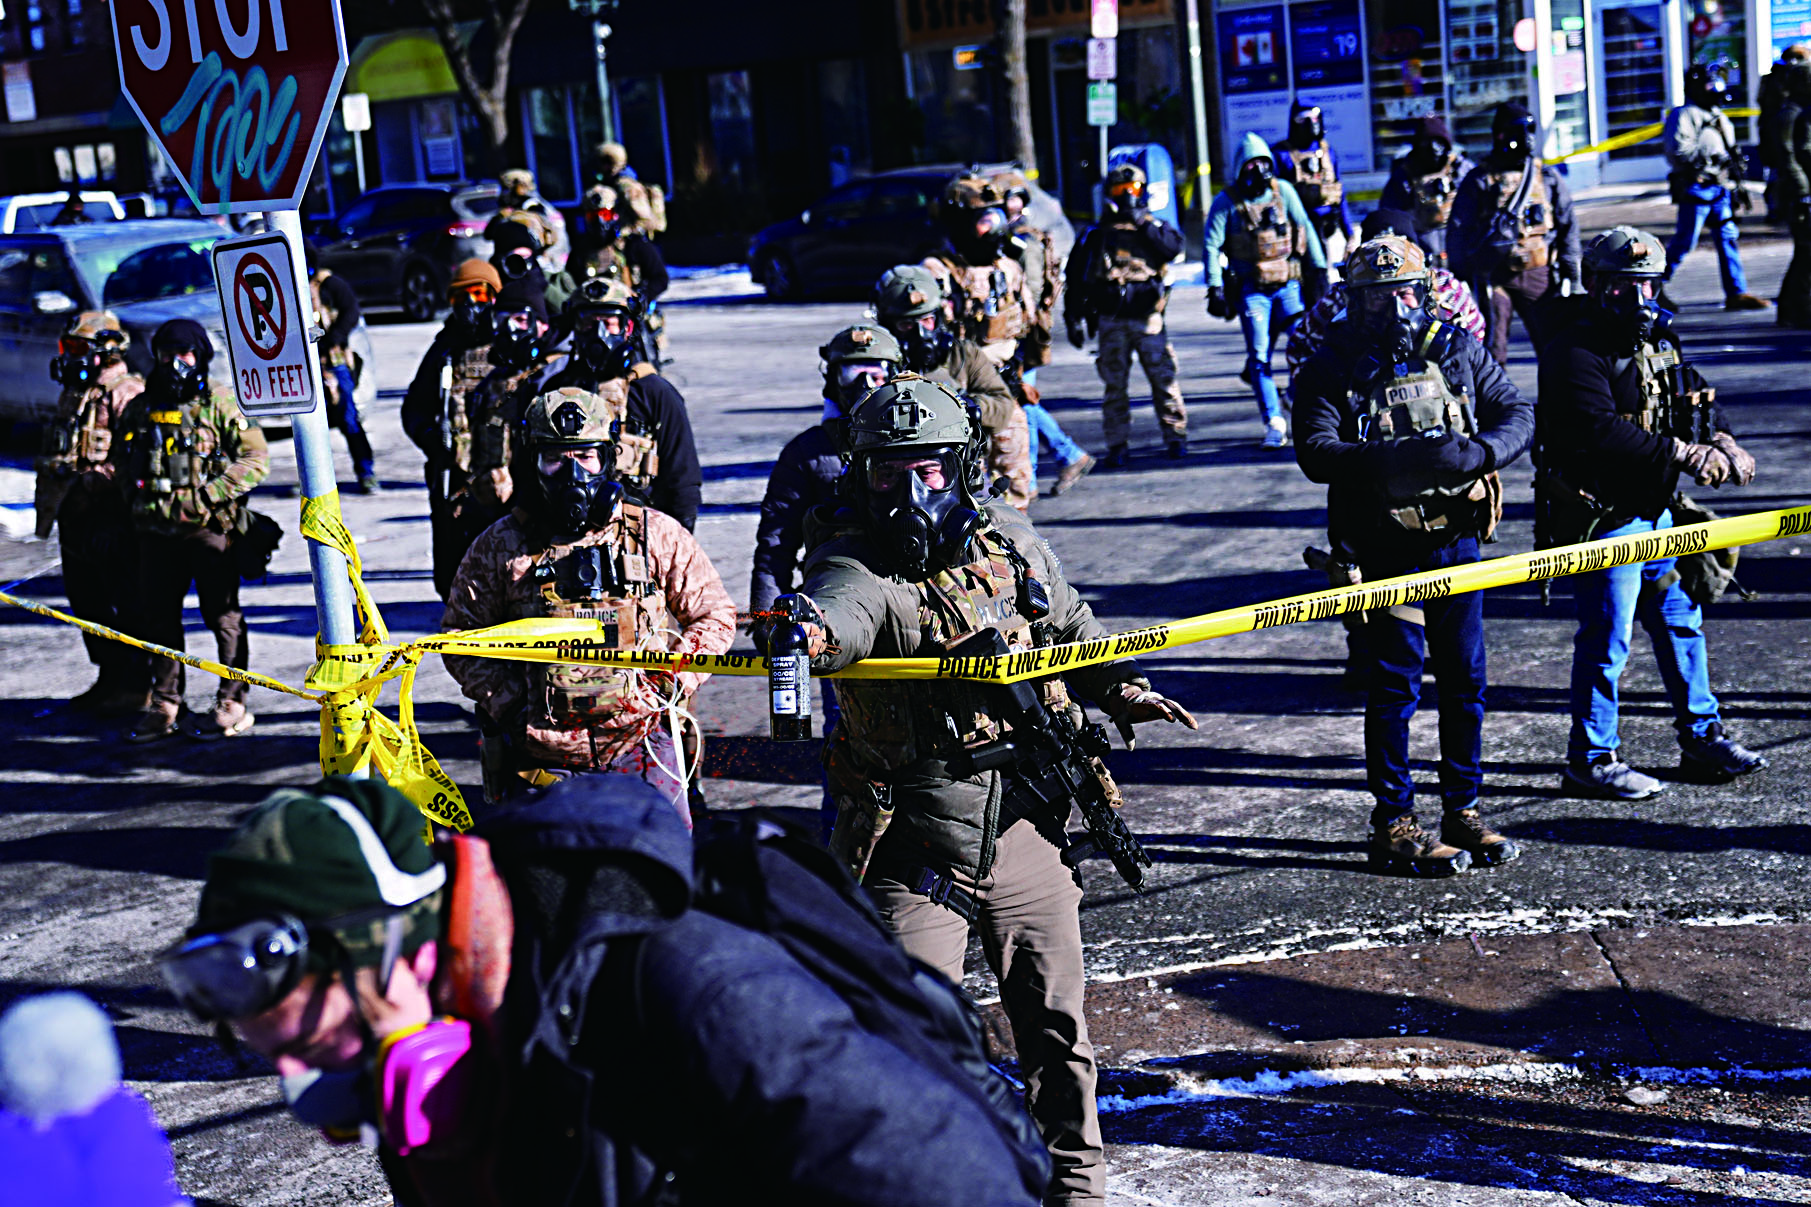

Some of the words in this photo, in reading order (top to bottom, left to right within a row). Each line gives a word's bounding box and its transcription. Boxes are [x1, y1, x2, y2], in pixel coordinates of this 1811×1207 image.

[242, 367, 262, 400] 30
[267, 364, 305, 398] FEET
[1527, 552, 1575, 581] POLICE
[1576, 546, 1608, 573] LINE
[1610, 543, 1631, 566] DO
[1632, 536, 1662, 563] NOT
[1663, 529, 1709, 557] CROSS
[1252, 601, 1304, 631] POLICE
[1308, 593, 1342, 622] LINE
[1345, 588, 1366, 612] DO
[1371, 583, 1399, 610] NOT
[1404, 576, 1451, 603] CROSS
[714, 655, 756, 668] NOT
[936, 656, 1002, 680] POLICE
[1006, 651, 1045, 678] LINE
[1048, 645, 1072, 668] DO
[1075, 634, 1112, 662] NOT
[1113, 626, 1170, 655] CROSS
